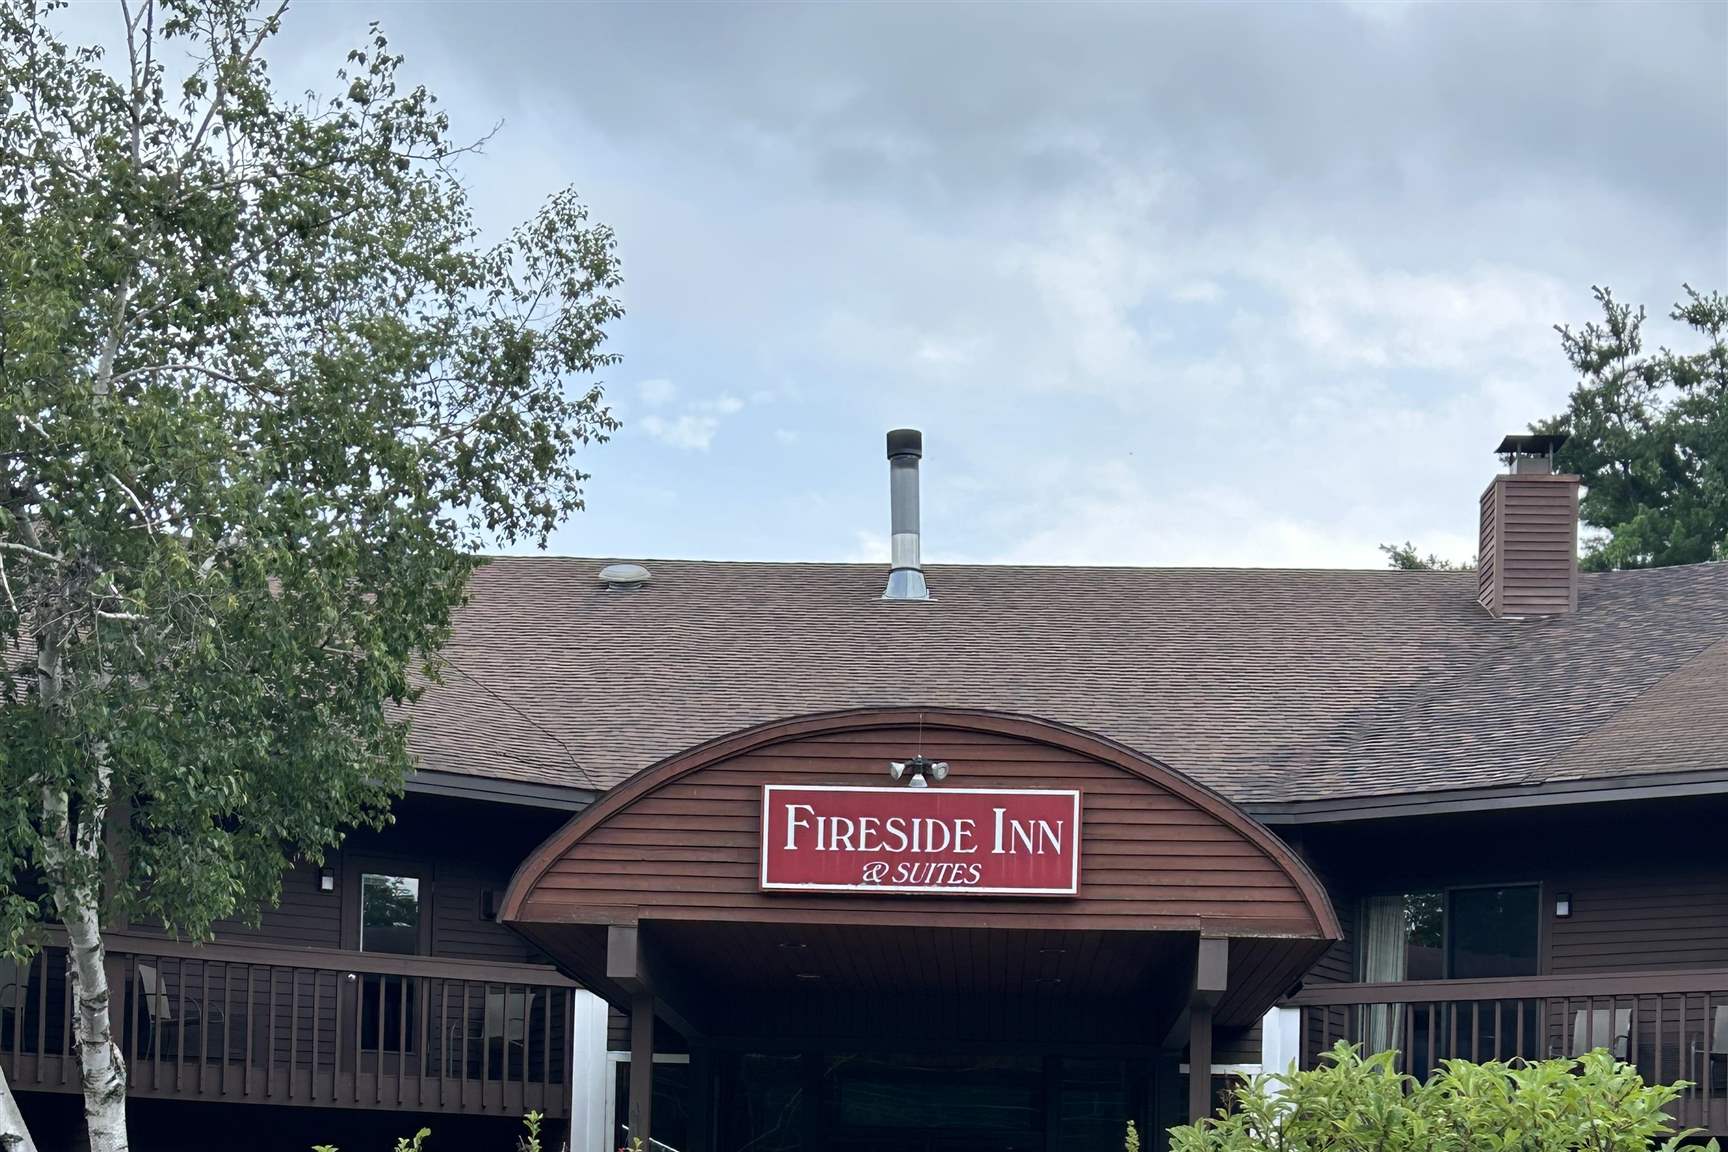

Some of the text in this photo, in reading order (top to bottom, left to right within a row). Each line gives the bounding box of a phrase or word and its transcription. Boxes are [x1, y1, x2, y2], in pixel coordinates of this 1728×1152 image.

[783, 803, 1064, 855] FIRESIDE INN
[862, 861, 982, 884] & SUITES
